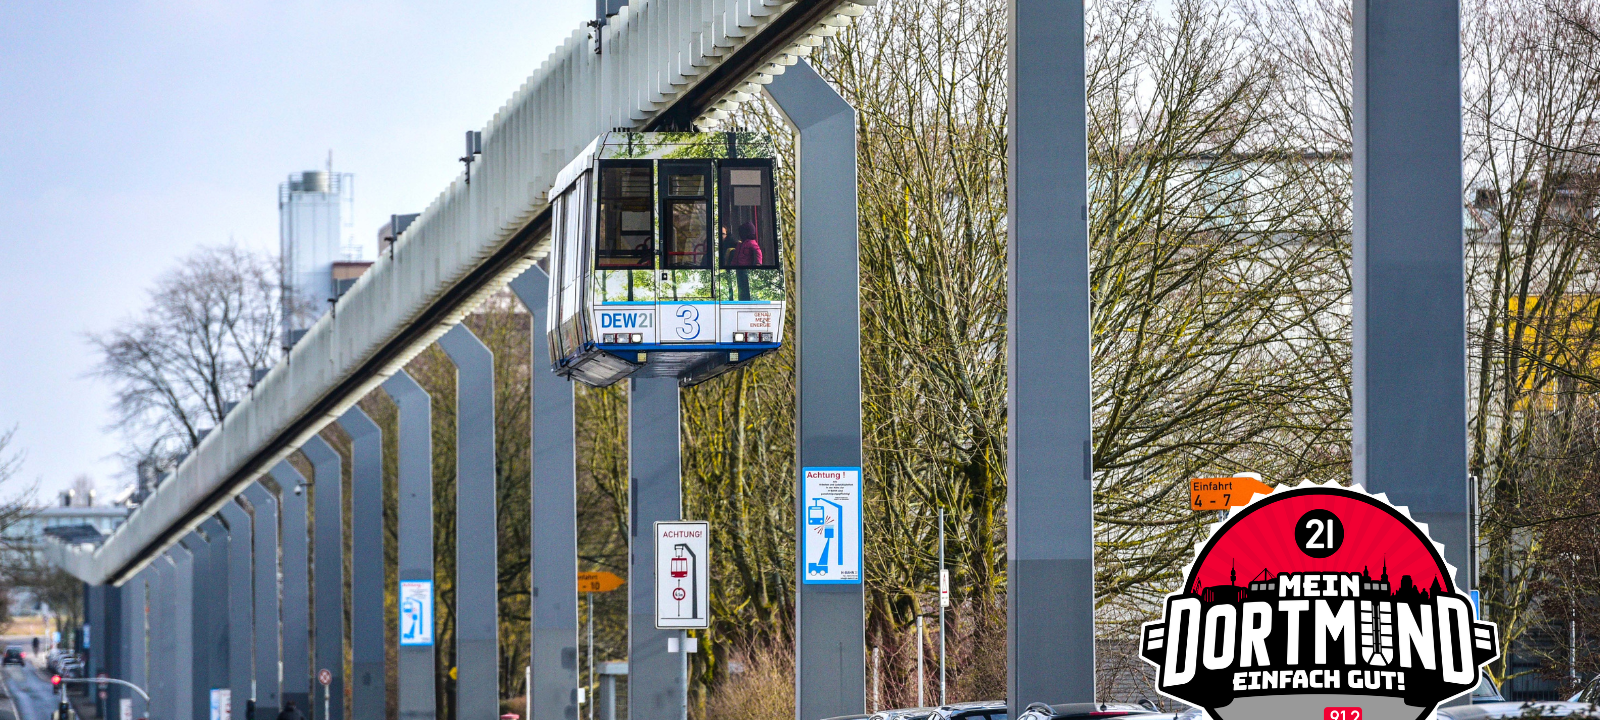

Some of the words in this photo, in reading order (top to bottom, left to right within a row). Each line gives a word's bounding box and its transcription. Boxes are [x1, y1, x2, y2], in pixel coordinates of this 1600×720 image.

[675, 304, 701, 340] 3
[806, 471, 841, 480] Achtung
[1193, 481, 1233, 491] Einfahrt
[1194, 494, 1203, 507] 4
[1223, 494, 1231, 506] 7
[662, 530, 703, 538] ACHTUNG!
